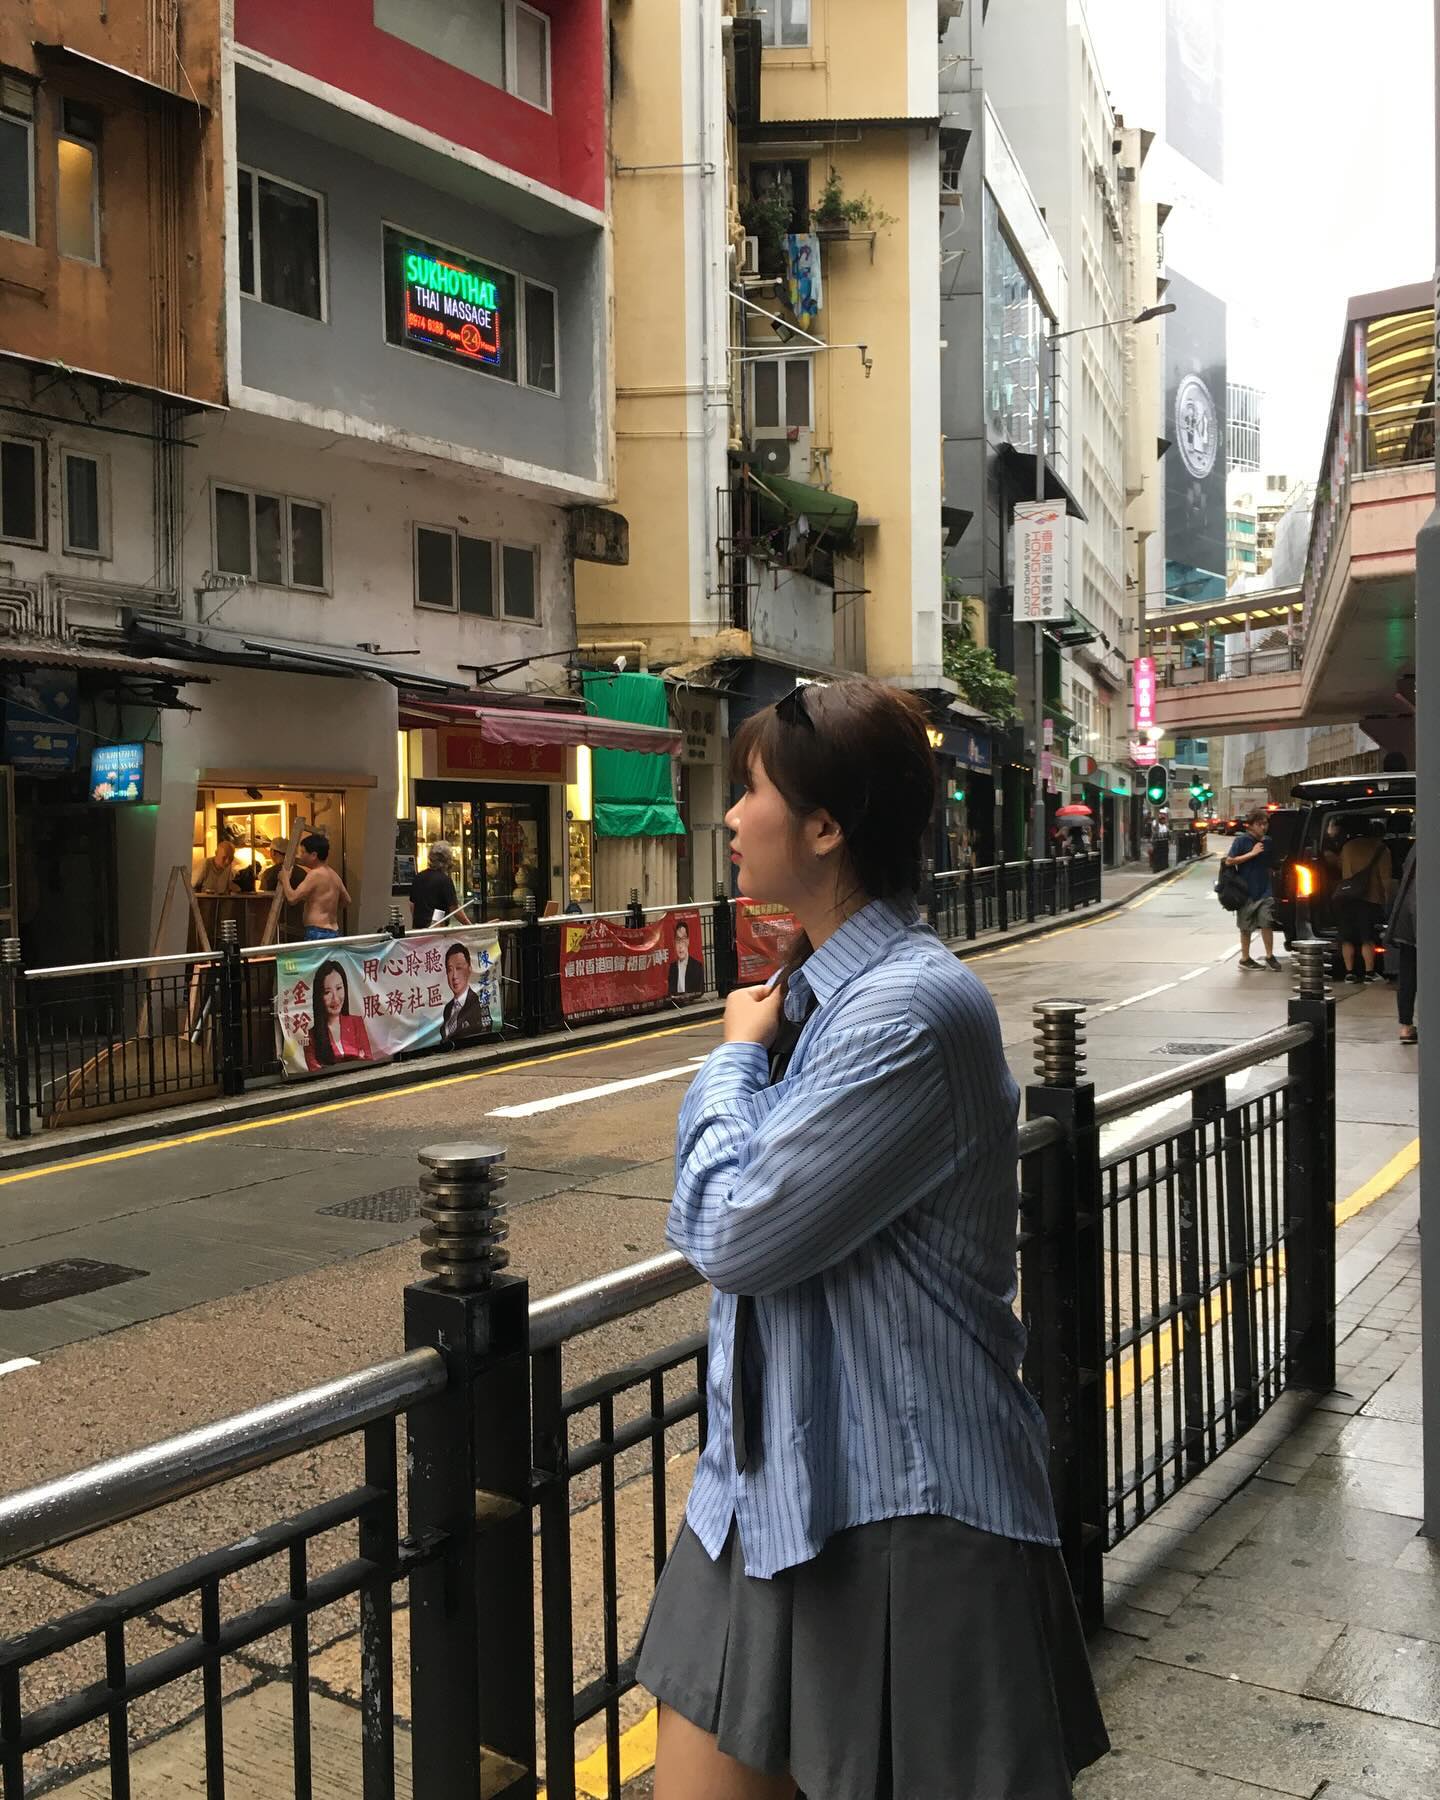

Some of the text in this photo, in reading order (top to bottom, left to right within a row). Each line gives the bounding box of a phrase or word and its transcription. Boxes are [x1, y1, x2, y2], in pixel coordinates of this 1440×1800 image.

[407, 255, 496, 309] SUKHOTHAI
[414, 285, 492, 329] THAI MASSAGE
[463, 329, 478, 346] 24
[1031, 531, 1041, 617] HONG KONG
[363, 947, 444, 984] 用心聆聽
[292, 980, 312, 1035] 金玲
[362, 983, 444, 1019] 服務社區
